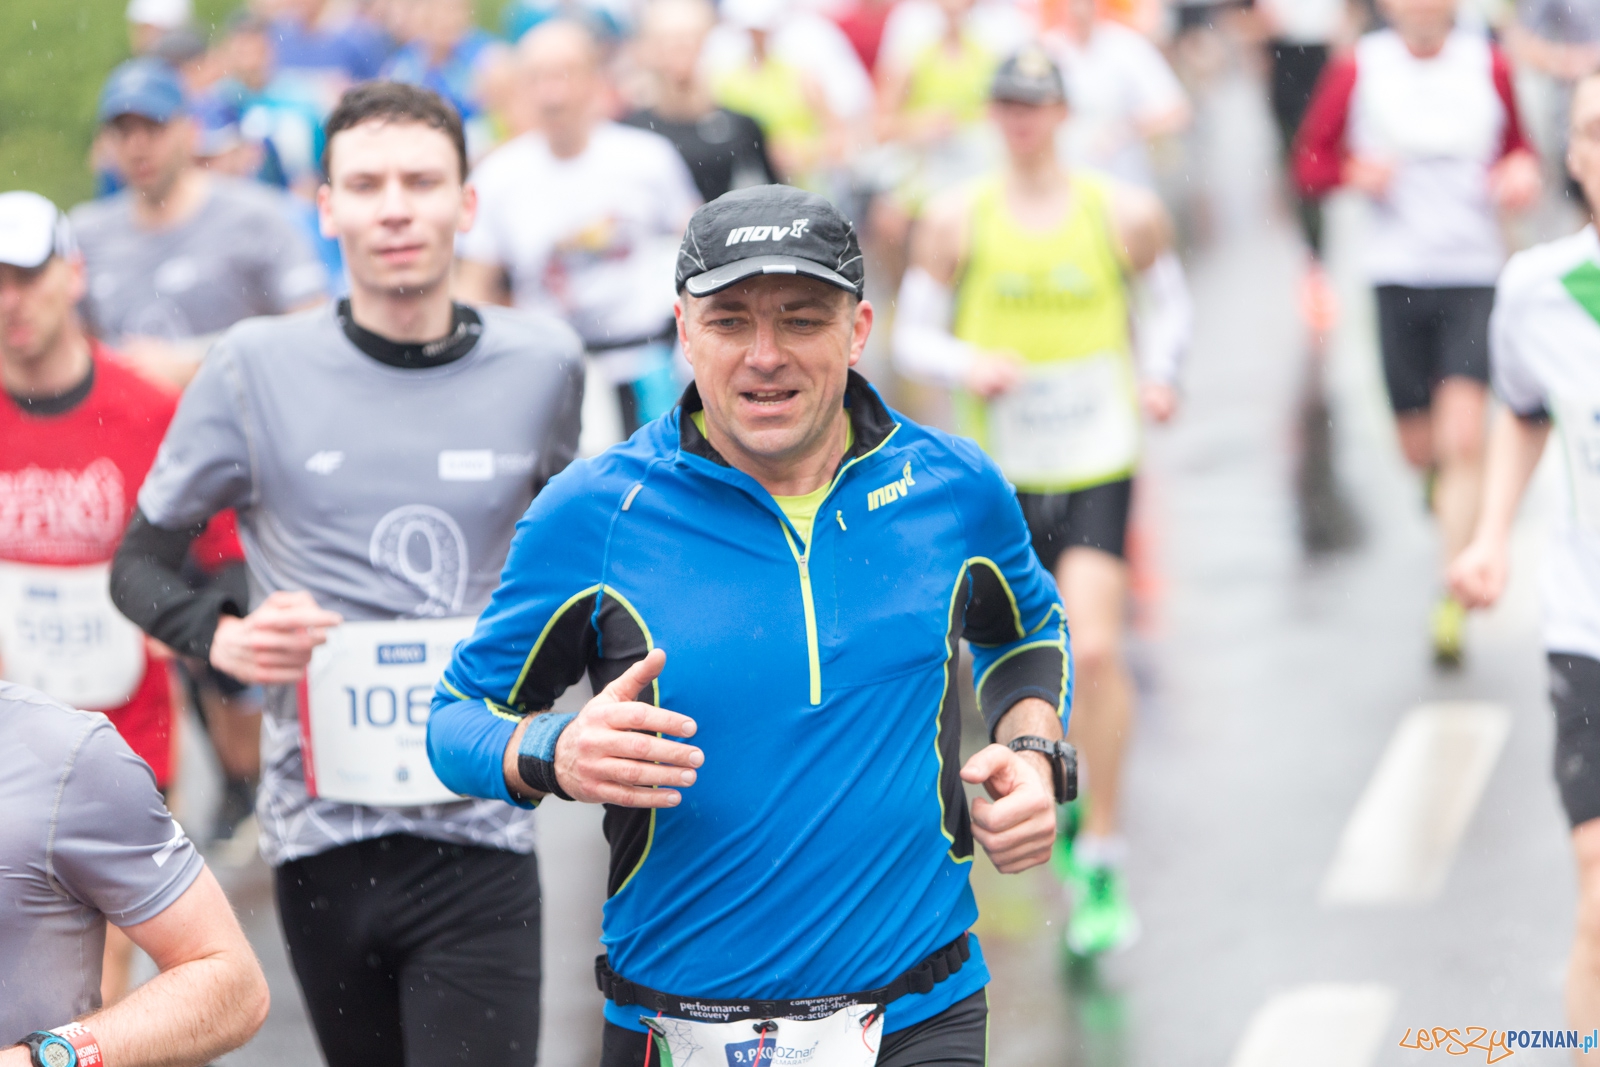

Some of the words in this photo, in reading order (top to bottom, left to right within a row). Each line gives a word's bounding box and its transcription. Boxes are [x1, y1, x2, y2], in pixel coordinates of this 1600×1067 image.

[679, 1002, 750, 1013] performance
[808, 999, 860, 1013] anti-shock
[689, 1010, 730, 1021] recovery
[76, 1043, 99, 1058] FINISH
